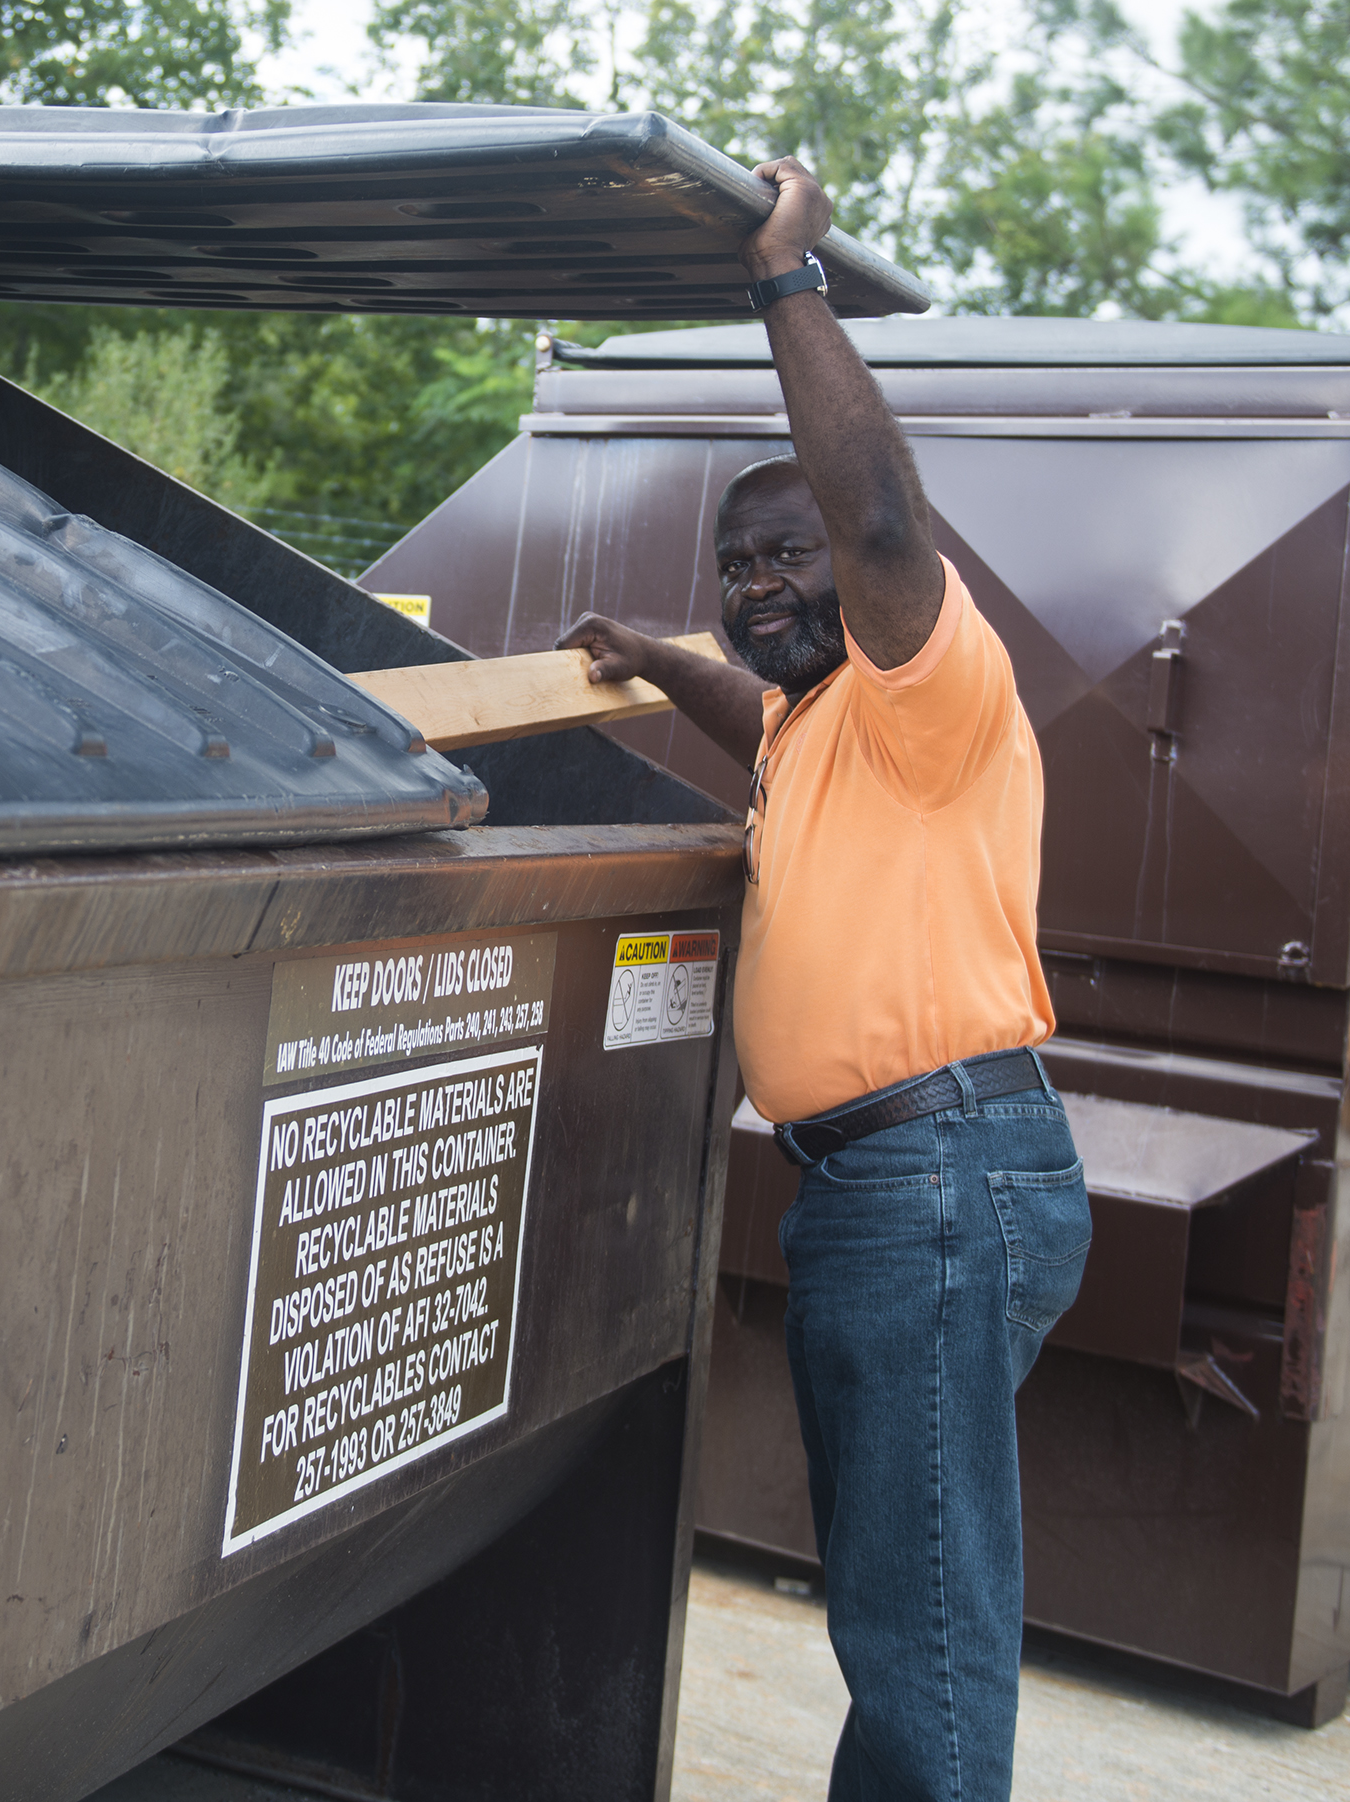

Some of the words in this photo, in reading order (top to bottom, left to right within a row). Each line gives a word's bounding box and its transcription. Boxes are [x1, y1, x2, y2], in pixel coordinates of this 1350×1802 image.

[390, 601, 425, 612] TION
[332, 962, 370, 1012] KEEP
[371, 955, 423, 1006] DOORS
[423, 953, 434, 1004] /
[433, 950, 465, 998] LIDS
[466, 946, 513, 993] CLOSED
[626, 941, 667, 961] CAUTION
[678, 938, 716, 958] WARNING
[276, 1041, 298, 1072] IAW
[298, 1038, 317, 1069] Title
[318, 1036, 330, 1064] 40
[332, 1031, 351, 1063] Code
[353, 1028, 365, 1058] of
[364, 1023, 397, 1056] Federal
[397, 1019, 442, 1056] Regulations
[444, 1016, 464, 1042] Parts
[465, 1012, 481, 1040] 240,
[483, 1008, 498, 1037] 241,
[500, 1006, 514, 1034] 243,
[515, 1003, 529, 1031] 257,
[530, 1000, 544, 1027] 258
[271, 1120, 299, 1171] NO
[302, 1093, 417, 1163] RECYCLABLE
[418, 1073, 504, 1132] MATERIALS
[504, 1067, 534, 1111] ARE
[279, 1159, 366, 1227] ALLOWED
[369, 1153, 388, 1198] IN
[392, 1141, 429, 1192] THIS
[431, 1121, 516, 1180] CONTAINER.
[294, 1199, 411, 1278] RECYCLABLE
[412, 1174, 498, 1238] MATERIALS
[269, 1270, 358, 1345] DISPOSED
[361, 1259, 386, 1308] OF
[387, 1251, 412, 1299] AS
[414, 1230, 478, 1289] REFUSE
[478, 1224, 493, 1267] IS
[493, 1221, 504, 1260] A
[284, 1317, 374, 1395] VIOLATION
[377, 1306, 402, 1355] OF
[402, 1296, 431, 1346] AFI
[432, 1276, 488, 1334] 32-7042.
[260, 1403, 299, 1463] FOR
[302, 1350, 426, 1442] RECYCLABLES
[428, 1322, 499, 1385] CONTACT
[294, 1427, 367, 1501] 257-1993
[371, 1414, 396, 1462] OR
[398, 1384, 462, 1450] 257-3849
